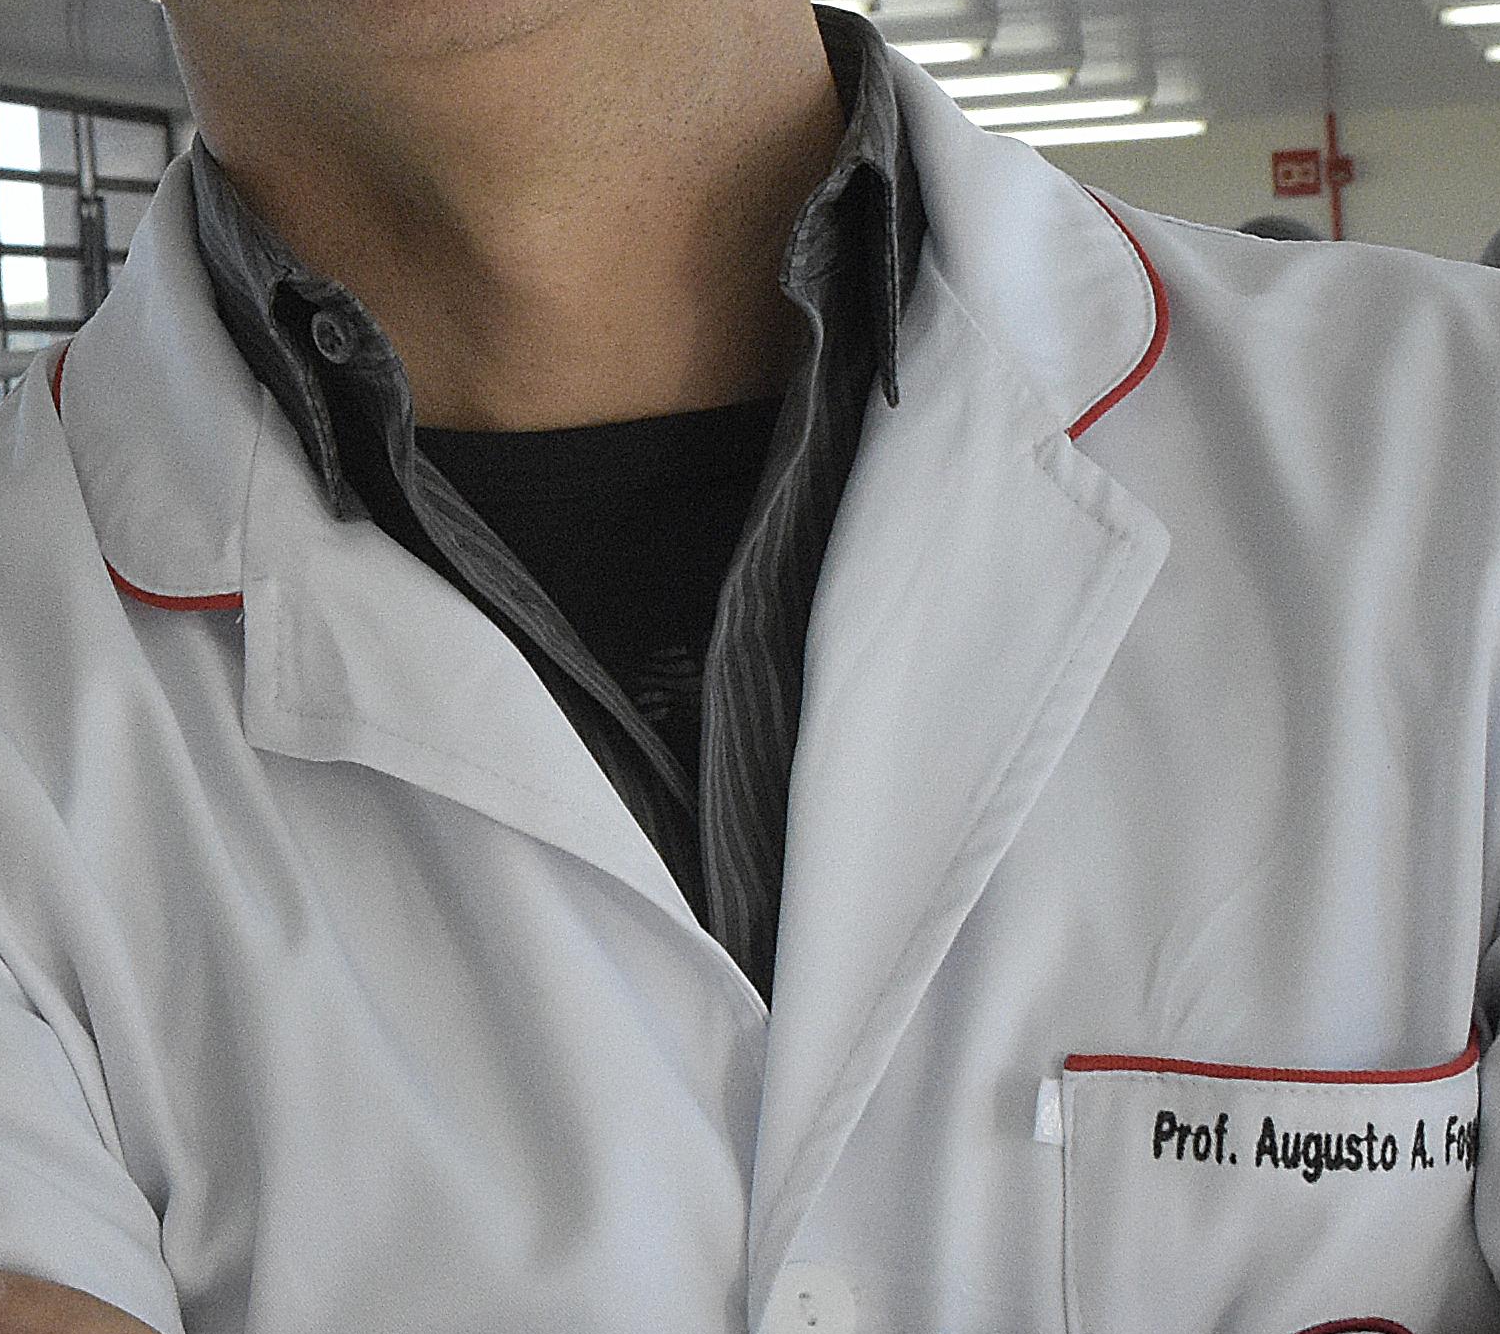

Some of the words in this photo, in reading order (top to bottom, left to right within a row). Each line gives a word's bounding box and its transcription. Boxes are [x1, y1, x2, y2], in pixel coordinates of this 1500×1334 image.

[1153, 1110, 1237, 1165] Prof.
[1255, 1116, 1398, 1183] Augusto
[1411, 1119, 1434, 1171] A.
